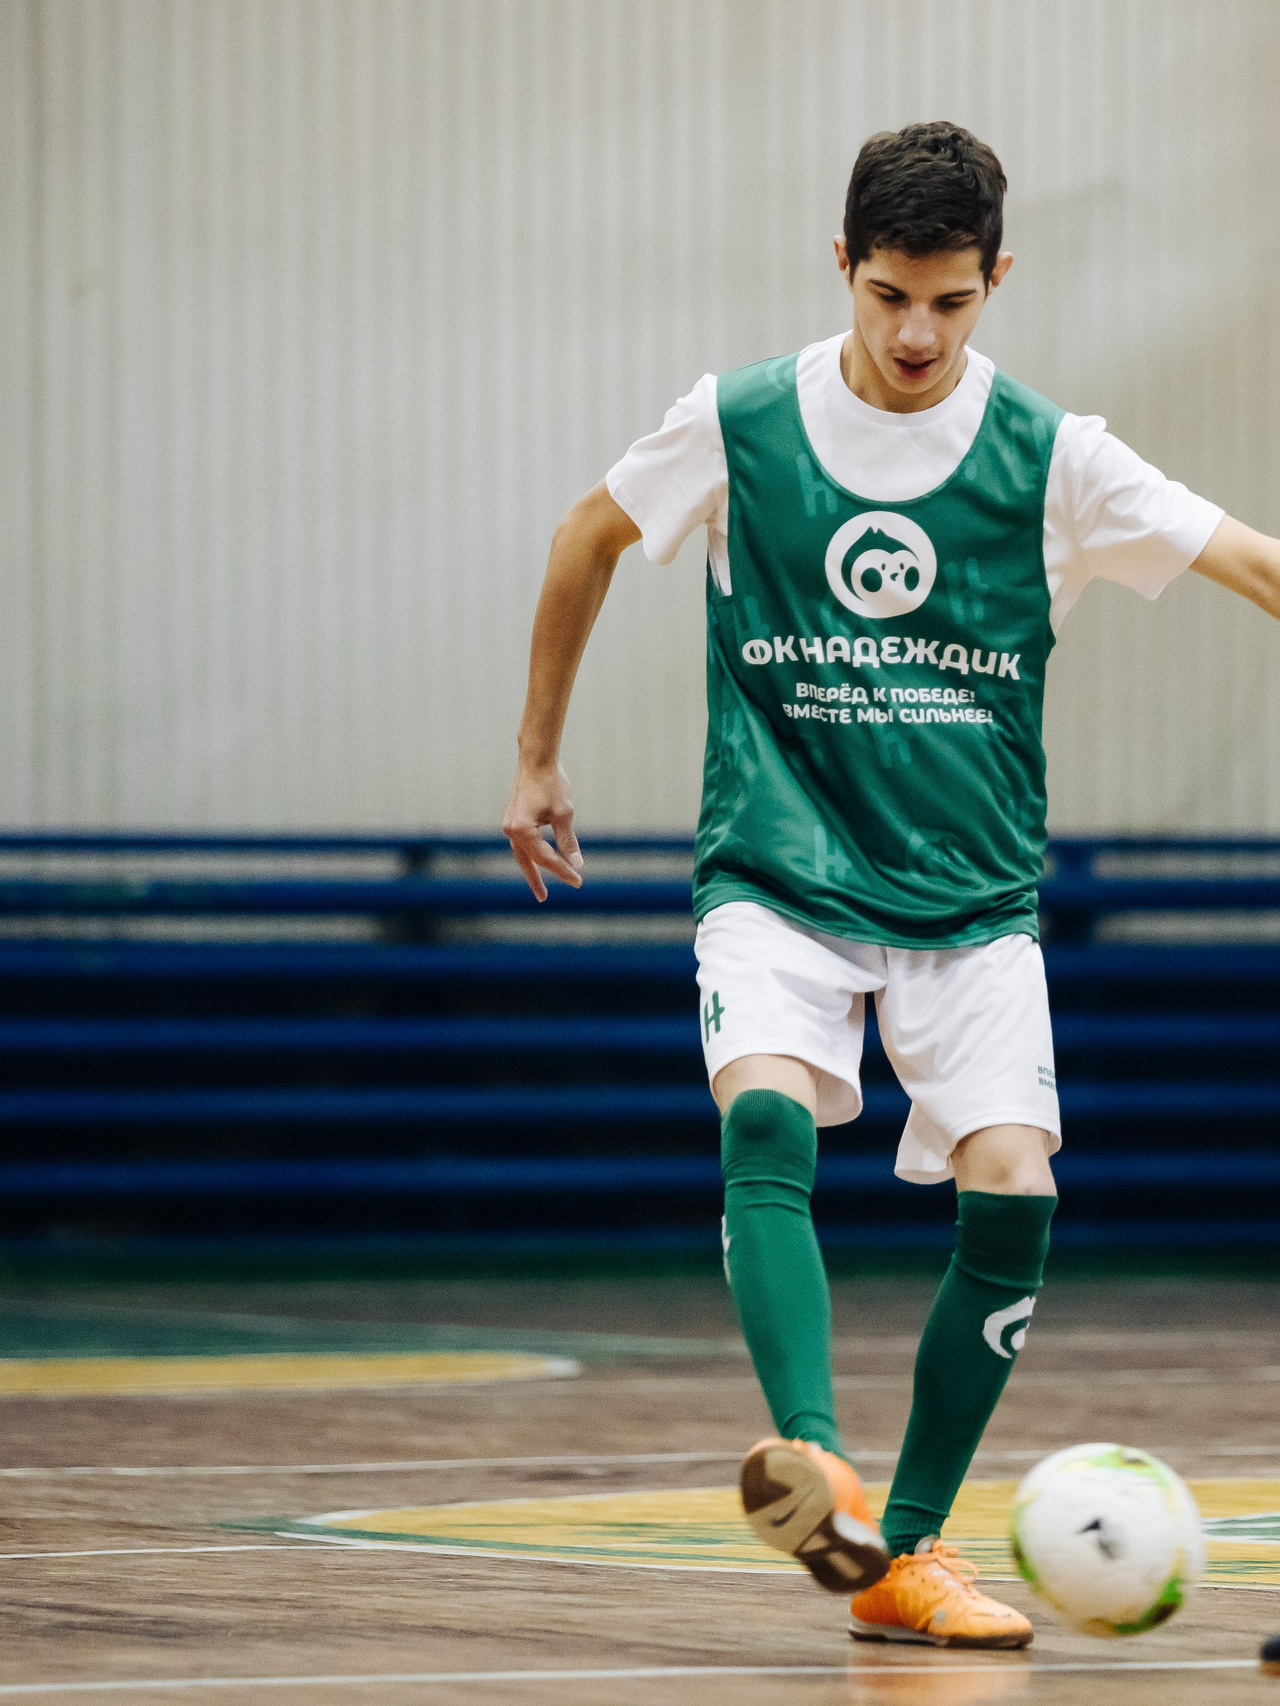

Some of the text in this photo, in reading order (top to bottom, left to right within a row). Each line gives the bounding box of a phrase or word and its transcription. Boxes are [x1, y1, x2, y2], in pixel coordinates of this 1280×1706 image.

[799, 635, 1021, 681] НАДЕЖДИК
[795, 682, 975, 705] ВПЕРЁД К ПОБЕДЕ!
[782, 703, 994, 724] ВМЕСТЕ МЫ СИЛЬНЕЕ!
